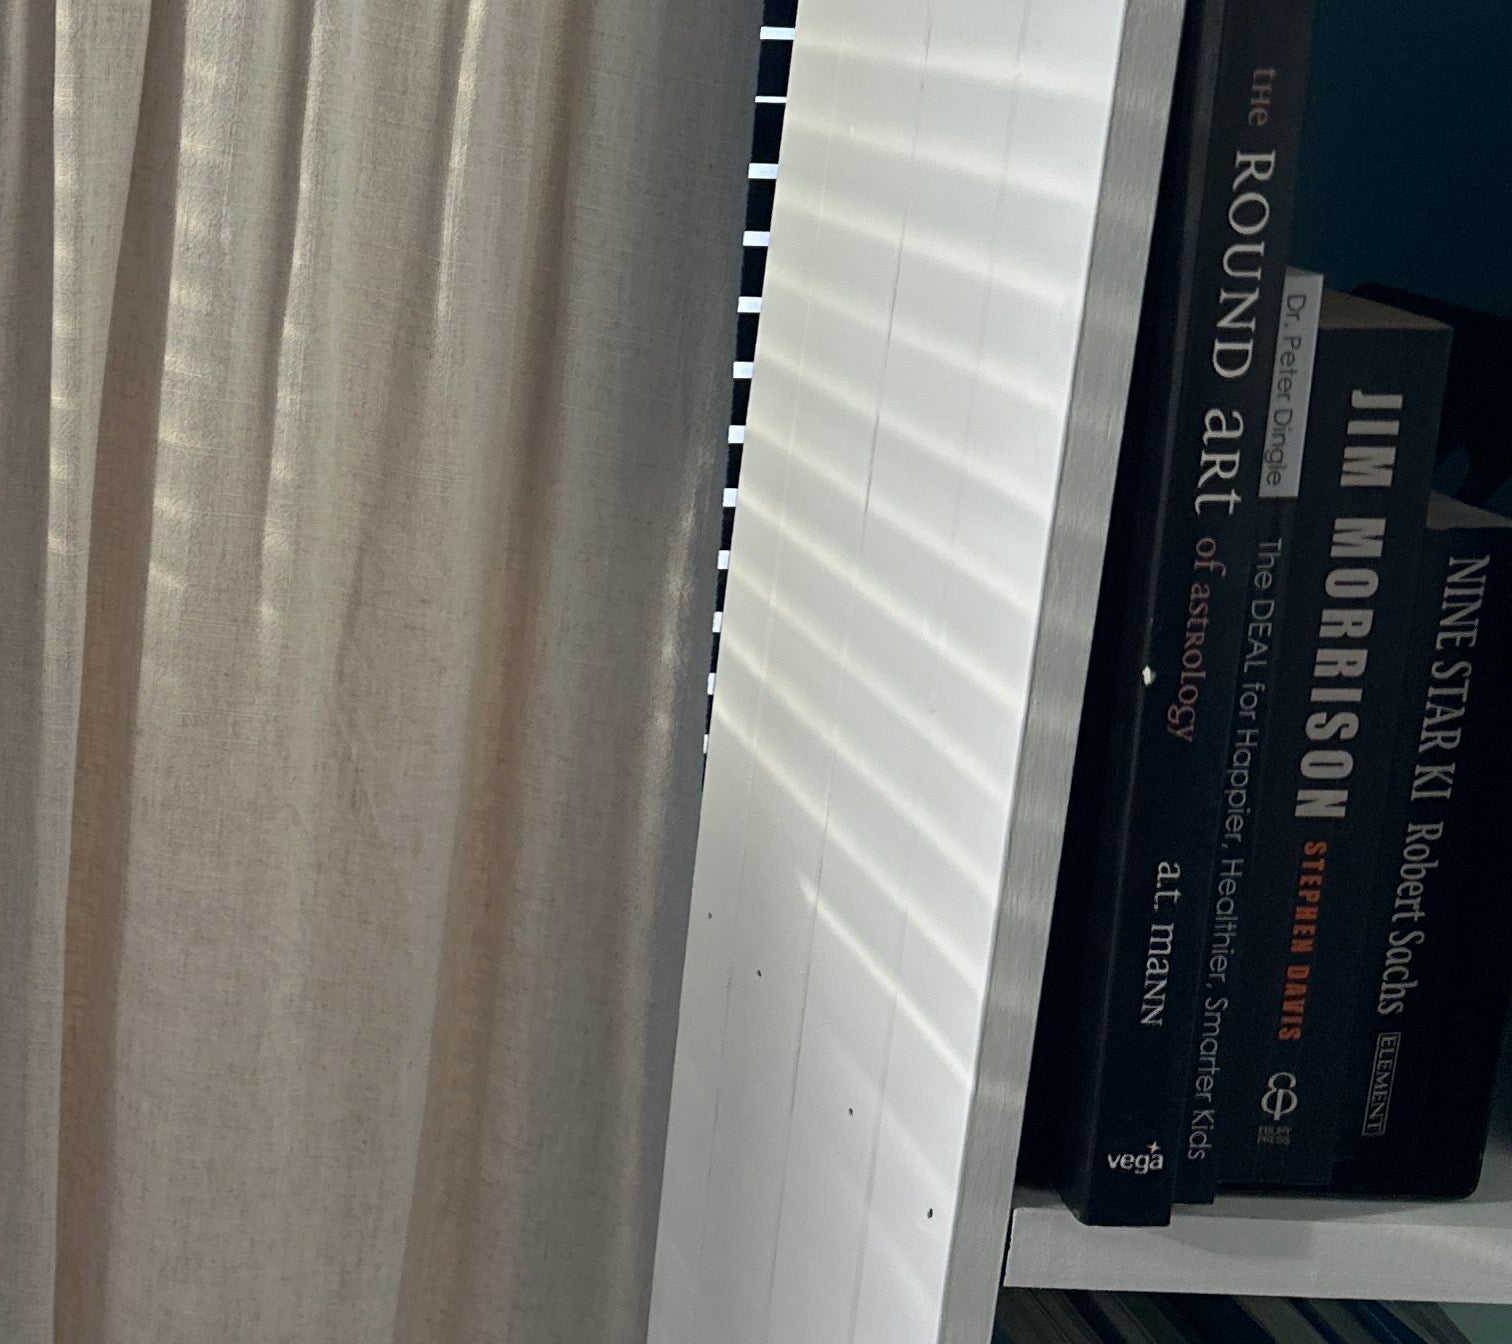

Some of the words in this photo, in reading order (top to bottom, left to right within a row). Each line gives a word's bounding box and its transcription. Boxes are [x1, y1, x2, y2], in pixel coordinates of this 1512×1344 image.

[1210, 149, 1277, 380] ROUND
[1283, 294, 1307, 329] Dr.
[1277, 335, 1302, 401] Peter
[1263, 409, 1293, 486] Dingle
[1339, 388, 1404, 488] JIM
[1193, 537, 1227, 579] of
[1253, 537, 1283, 591] The
[1242, 598, 1276, 674] DEAL
[1434, 554, 1491, 651] NINE
[1238, 681, 1266, 722] for
[1293, 517, 1387, 819] MORRISON
[1417, 659, 1473, 754] STAR
[1221, 728, 1259, 849] Happier,
[1409, 761, 1457, 802] KI
[1289, 839, 1329, 954] STEPHEN
[1391, 820, 1445, 923] Robert
[1205, 858, 1244, 989] Healthier,
[1276, 963, 1312, 1041] DAVIS
[1376, 929, 1426, 1016] Sachs
[1194, 996, 1229, 1105] Smarter
[1365, 1035, 1396, 1134] ELEMENT
[1106, 1151, 1165, 1175] vega
[1187, 1109, 1216, 1161] Kids
